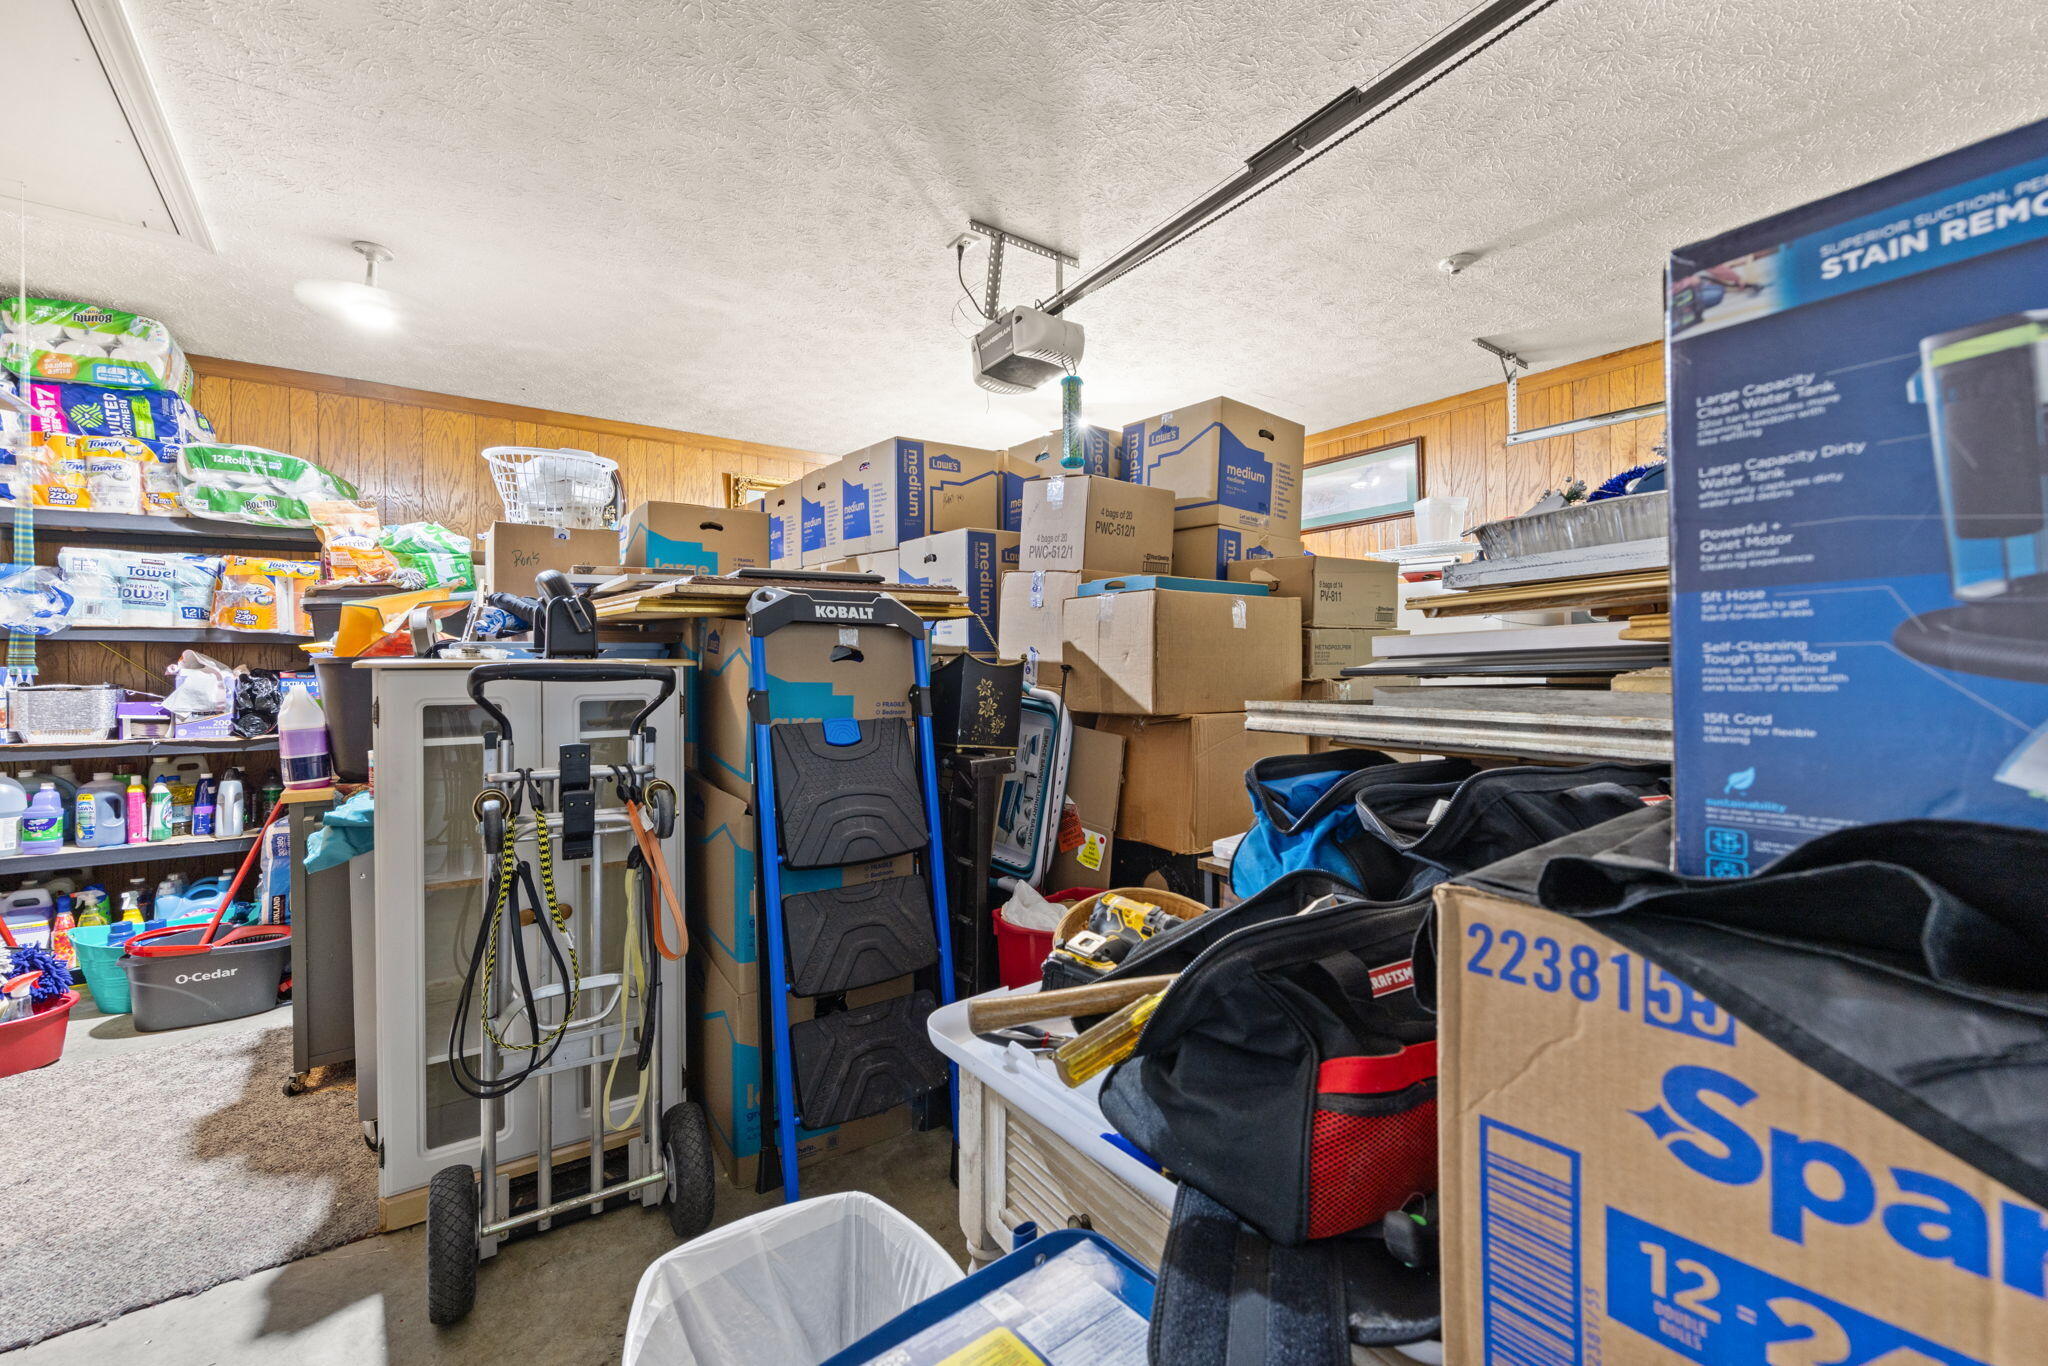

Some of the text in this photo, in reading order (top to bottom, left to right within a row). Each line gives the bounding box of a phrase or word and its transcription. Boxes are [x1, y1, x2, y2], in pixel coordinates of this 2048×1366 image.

[1820, 219, 1911, 258] SUPERIOR
[1820, 229, 1929, 280] STAIN
[73, 312, 112, 323] Bounty
[1696, 372, 1815, 407] Large Capacity
[1696, 380, 1836, 419] Clean Water Tank
[1151, 430, 1177, 444] LOWE'S
[88, 440, 122, 449] Towels
[212, 455, 224, 463] 12
[932, 458, 958, 471] LOWE'S
[1698, 442, 1867, 478] Large Capacity Dirty
[91, 464, 122, 472] Towels
[1226, 464, 1265, 484] medium
[908, 449, 921, 517] medium
[1698, 467, 1786, 490] Water Tank
[49, 492, 78, 500] 2200
[844, 501, 865, 514] medium
[1101, 507, 1133, 520] 4 bags of 20
[804, 516, 822, 528] medium
[1095, 521, 1136, 537] PWC-512/1
[1699, 521, 1767, 540] Powerful
[1037, 533, 1068, 544] 4 bags of 20
[1700, 533, 1794, 553] Quiet Motor
[1029, 545, 1073, 559] PWC-512/1
[127, 566, 177, 579] Towel
[980, 541, 993, 617] medium
[1323, 581, 1332, 589] bags
[1320, 590, 1342, 602] PV-811
[1725, 590, 1766, 602] Hose
[184, 607, 197, 617] 12
[815, 605, 874, 620] KOBALT
[1702, 641, 1808, 654] Self-Cleaning
[1702, 651, 1837, 666] Tough Stain Tool
[213, 719, 231, 727] 200
[1702, 712, 1773, 725] 15ft Cord
[175, 966, 238, 985] O-Cedar
[1370, 967, 1414, 991] RAFTSM
[1638, 1241, 1722, 1325] 12
[1653, 1300, 1707, 1338] DOUBLE
[1659, 1318, 1703, 1352] ROLLS
